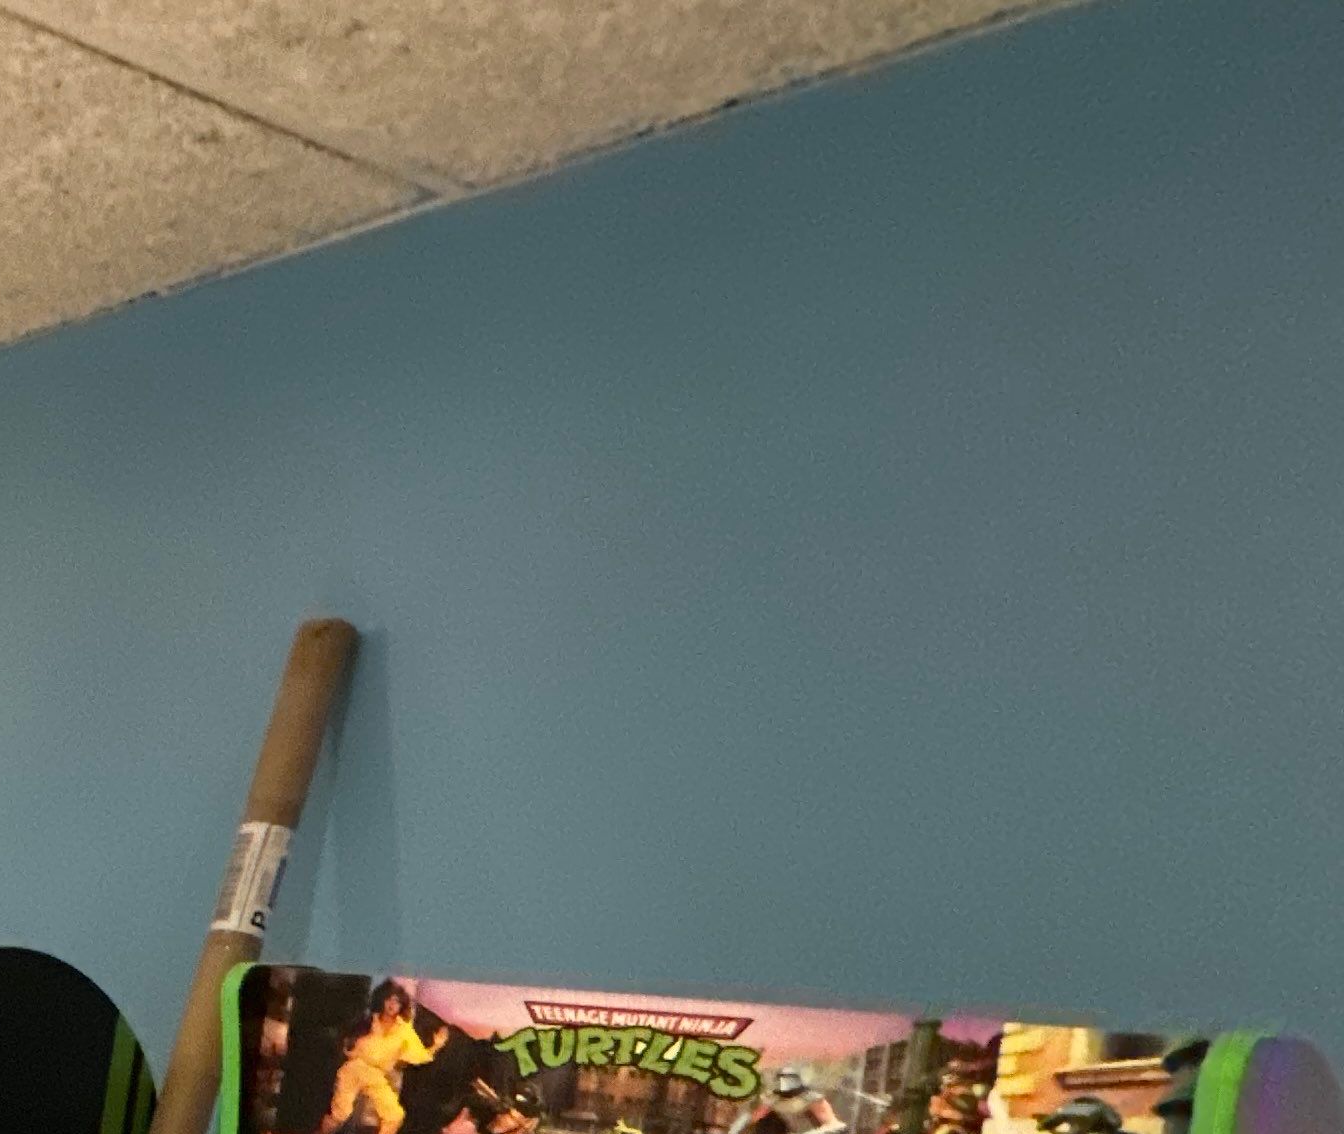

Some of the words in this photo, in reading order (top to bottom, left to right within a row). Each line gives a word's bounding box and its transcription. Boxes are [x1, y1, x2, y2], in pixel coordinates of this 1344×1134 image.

[533, 1005, 609, 1024] TEENAGE
[613, 1012, 677, 1029] MUTANT
[680, 1017, 738, 1035] NINJA
[494, 1027, 762, 1099] TURTLES
